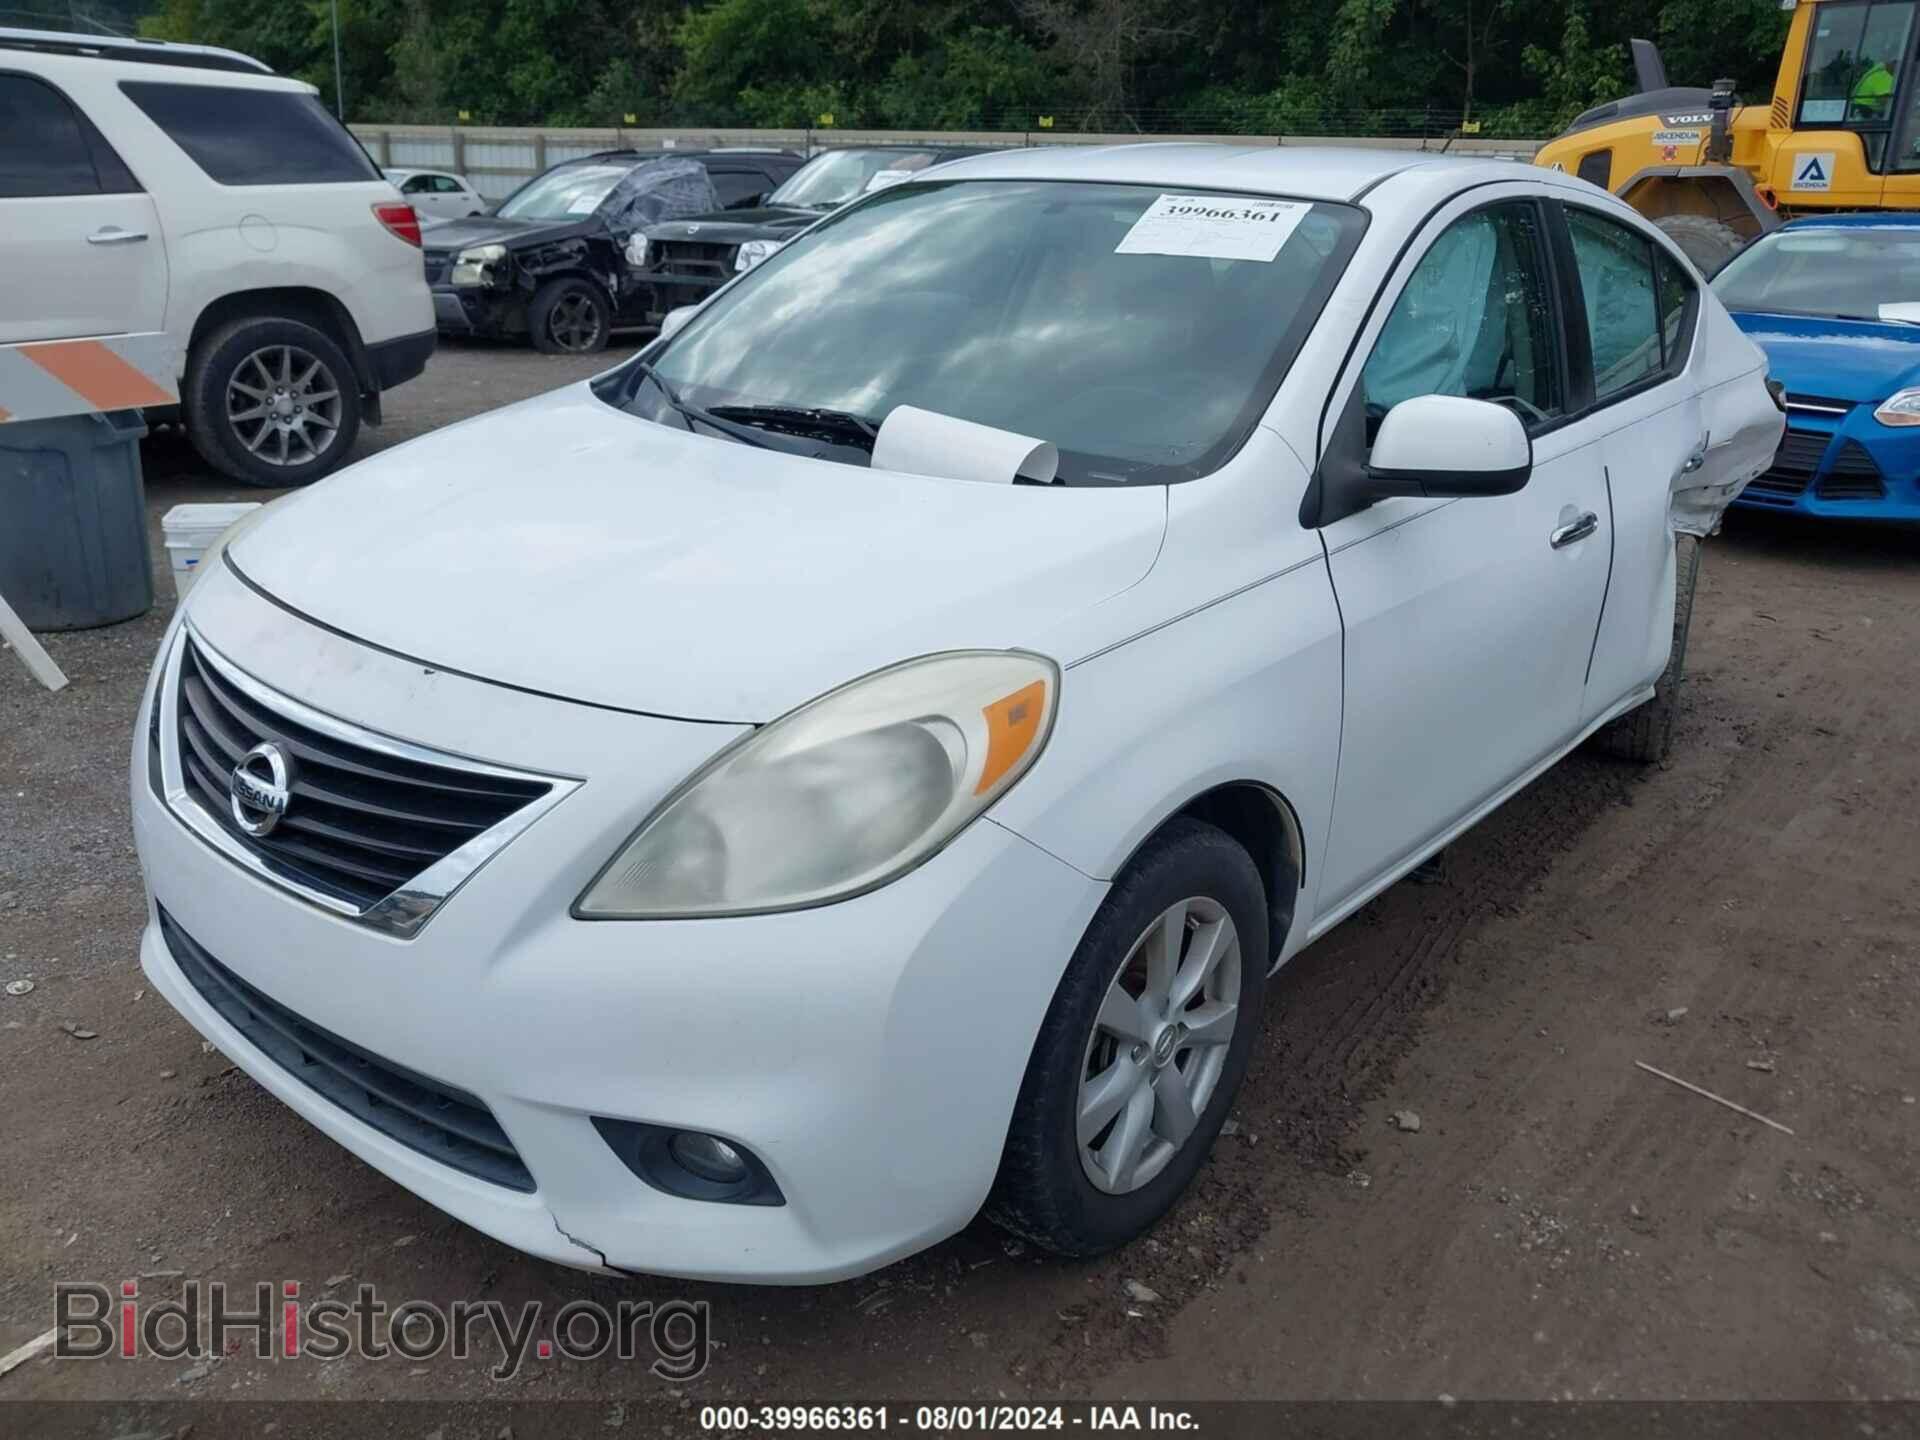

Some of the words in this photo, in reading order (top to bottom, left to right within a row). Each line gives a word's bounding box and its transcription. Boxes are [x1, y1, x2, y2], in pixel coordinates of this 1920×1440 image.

[1667, 113, 1714, 124] VOLV
[1159, 205, 1281, 223] 39966361
[235, 778, 275, 808] SSAN
